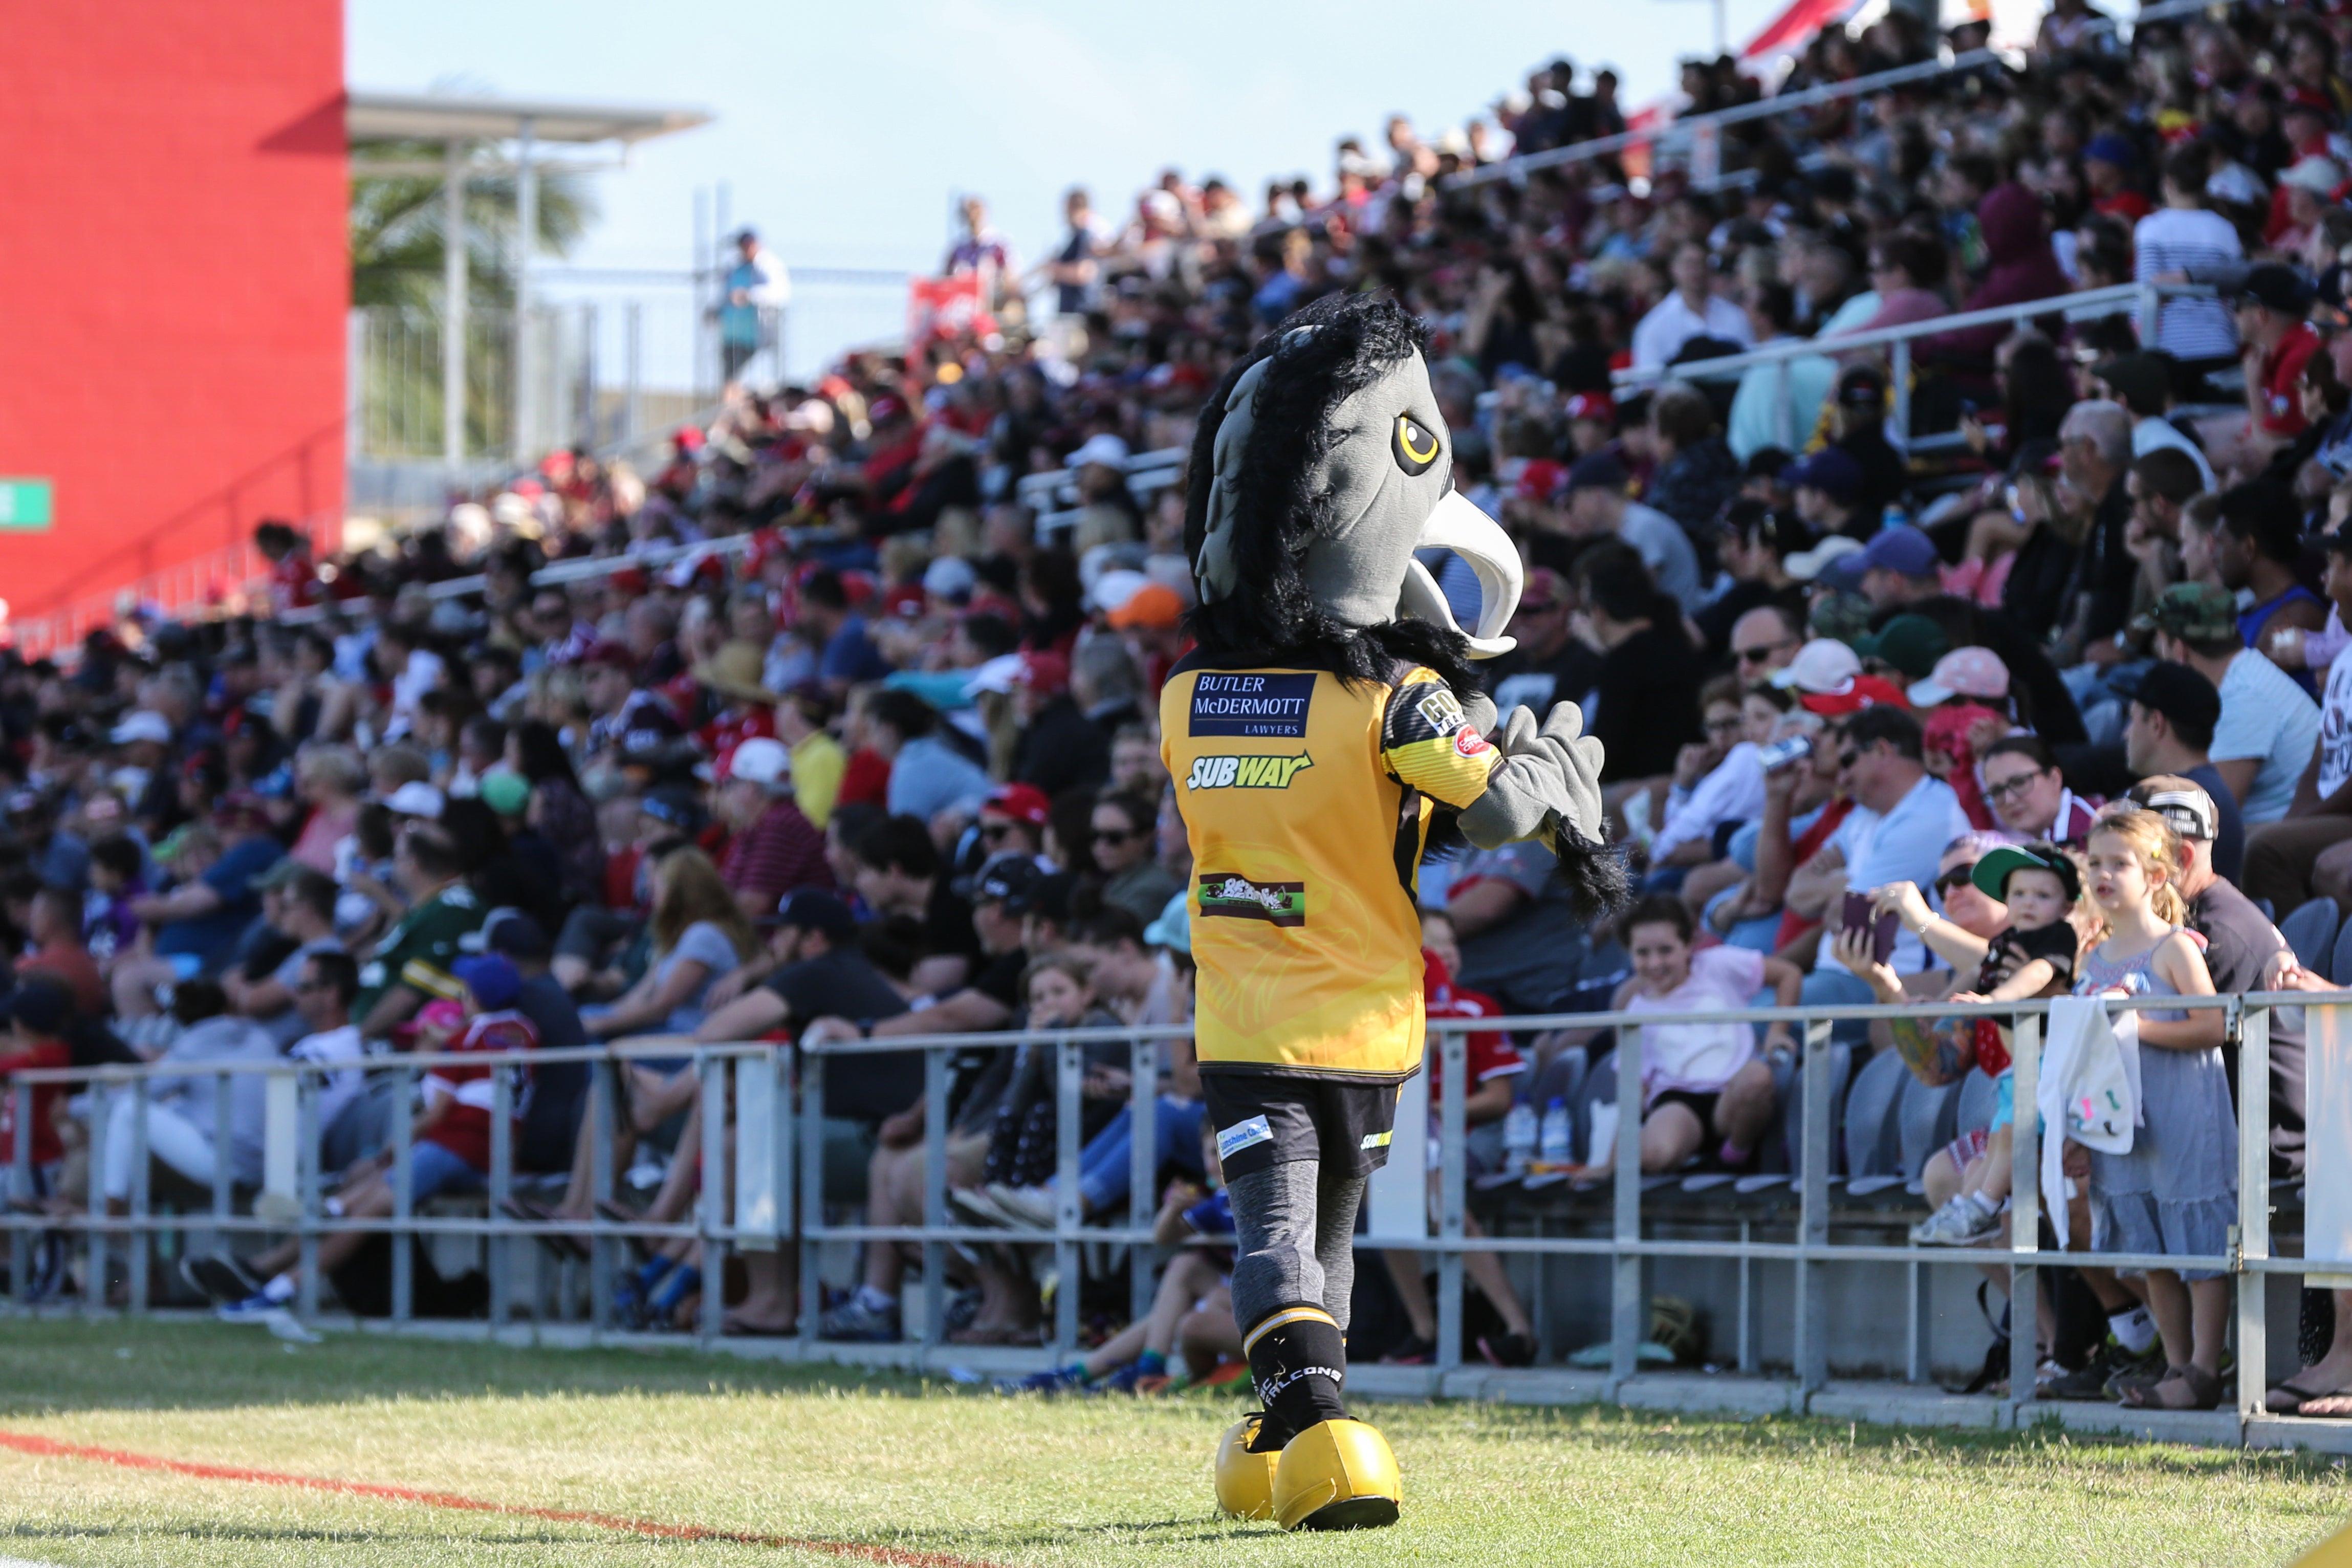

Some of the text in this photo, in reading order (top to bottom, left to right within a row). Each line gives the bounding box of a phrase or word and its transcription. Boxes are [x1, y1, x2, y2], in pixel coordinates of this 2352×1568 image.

[1199, 676, 1265, 692] BUTLER
[1194, 697, 1305, 715] McDERMOTT
[1245, 725, 1298, 734] LAWYERS
[1186, 749, 1315, 793] SUBWAY
[1265, 1366, 1343, 1407] FALCONS
